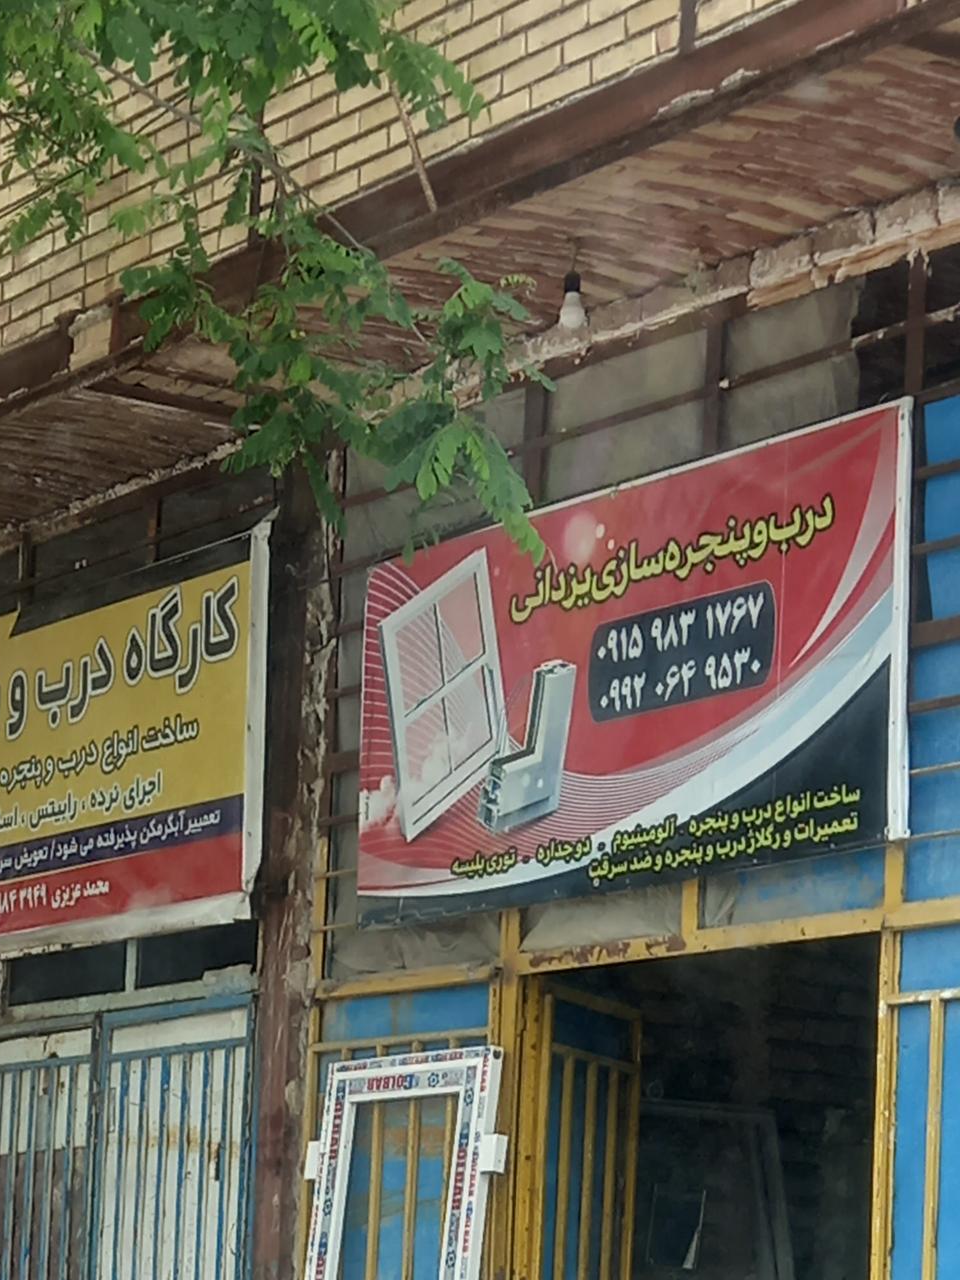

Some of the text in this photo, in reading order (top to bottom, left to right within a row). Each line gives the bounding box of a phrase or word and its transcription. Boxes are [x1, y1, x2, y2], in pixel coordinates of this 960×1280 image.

[124, 576, 239, 694] کارگاه
[597, 592, 764, 663] ۰۹۱۵ ۹۸۳ ۱۷۶۷
[36, 638, 114, 727] درب
[600, 646, 761, 712] ۰۹۹۲ ۰۶۴ ۹۵۳۰
[6, 671, 27, 739] و
[142, 713, 199, 751] ساخت
[57, 740, 98, 778] درب
[101, 724, 140, 774] انواع
[0, 756, 43, 794] پنجره
[43, 756, 55, 783] و
[90, 784, 120, 812] نرده
[123, 769, 163, 812] اجرای
[774, 791, 811, 822] انواع
[813, 784, 861, 809] ساخت
[29, 791, 77, 830] رابیتس
[140, 809, 185, 844] آبگرمکن
[688, 811, 729, 837] پنجره
[730, 811, 740, 830] و
[742, 802, 772, 827] درب
[80, 838, 93, 857] می
[96, 824, 138, 850] پذیرفته
[588, 812, 858, 880] تعمیرات و رگلاژ درب و پنجره و ضد سرقت
[612, 813, 677, 855] آلومینیوم
[14, 846, 48, 870] تعویض
[451, 851, 486, 878] پلیسه
[486, 847, 517, 875] توری
[51, 883, 82, 909] عزیزی
[83, 880, 110, 897] محمد
